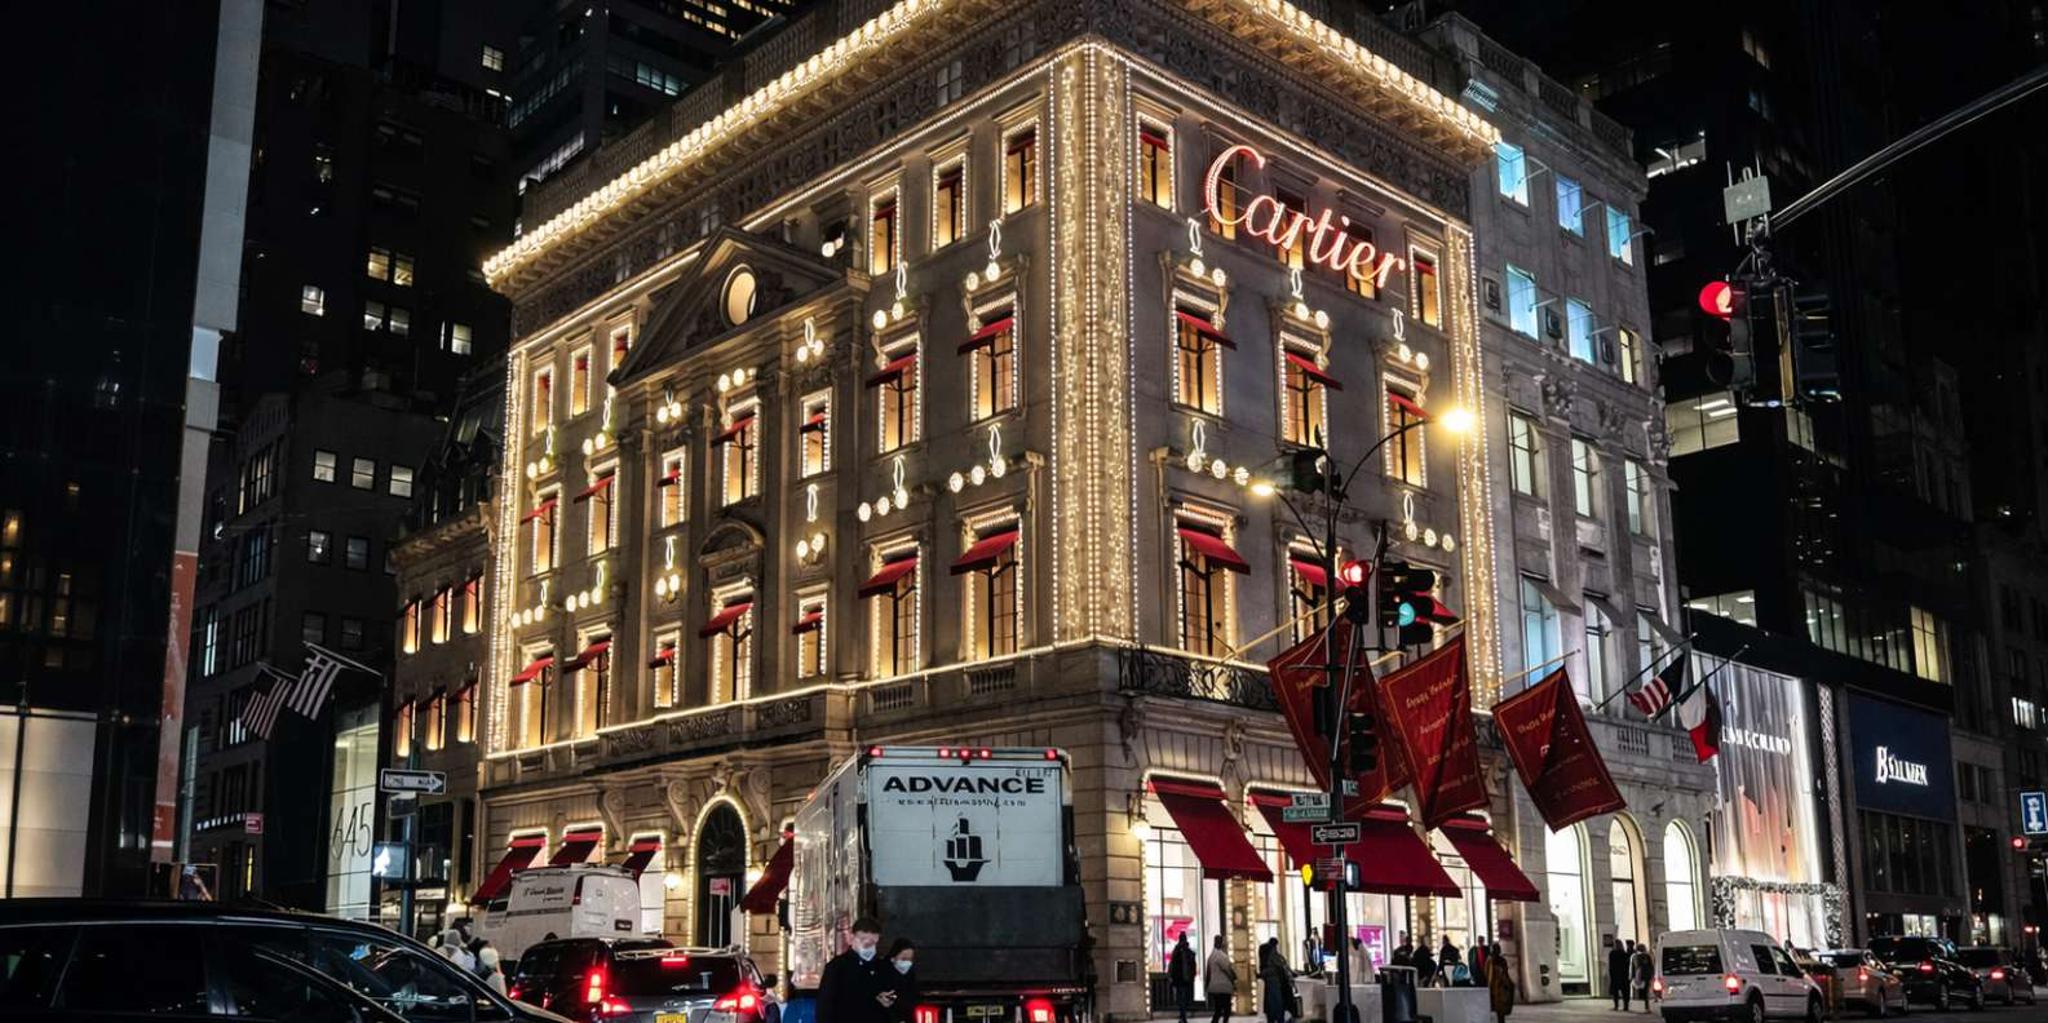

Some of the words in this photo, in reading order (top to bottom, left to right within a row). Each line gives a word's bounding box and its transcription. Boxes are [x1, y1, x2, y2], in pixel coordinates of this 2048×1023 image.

[1205, 146, 1405, 288] Cartier
[883, 776, 1045, 793] ADVANCE
[332, 802, 370, 860] 645
